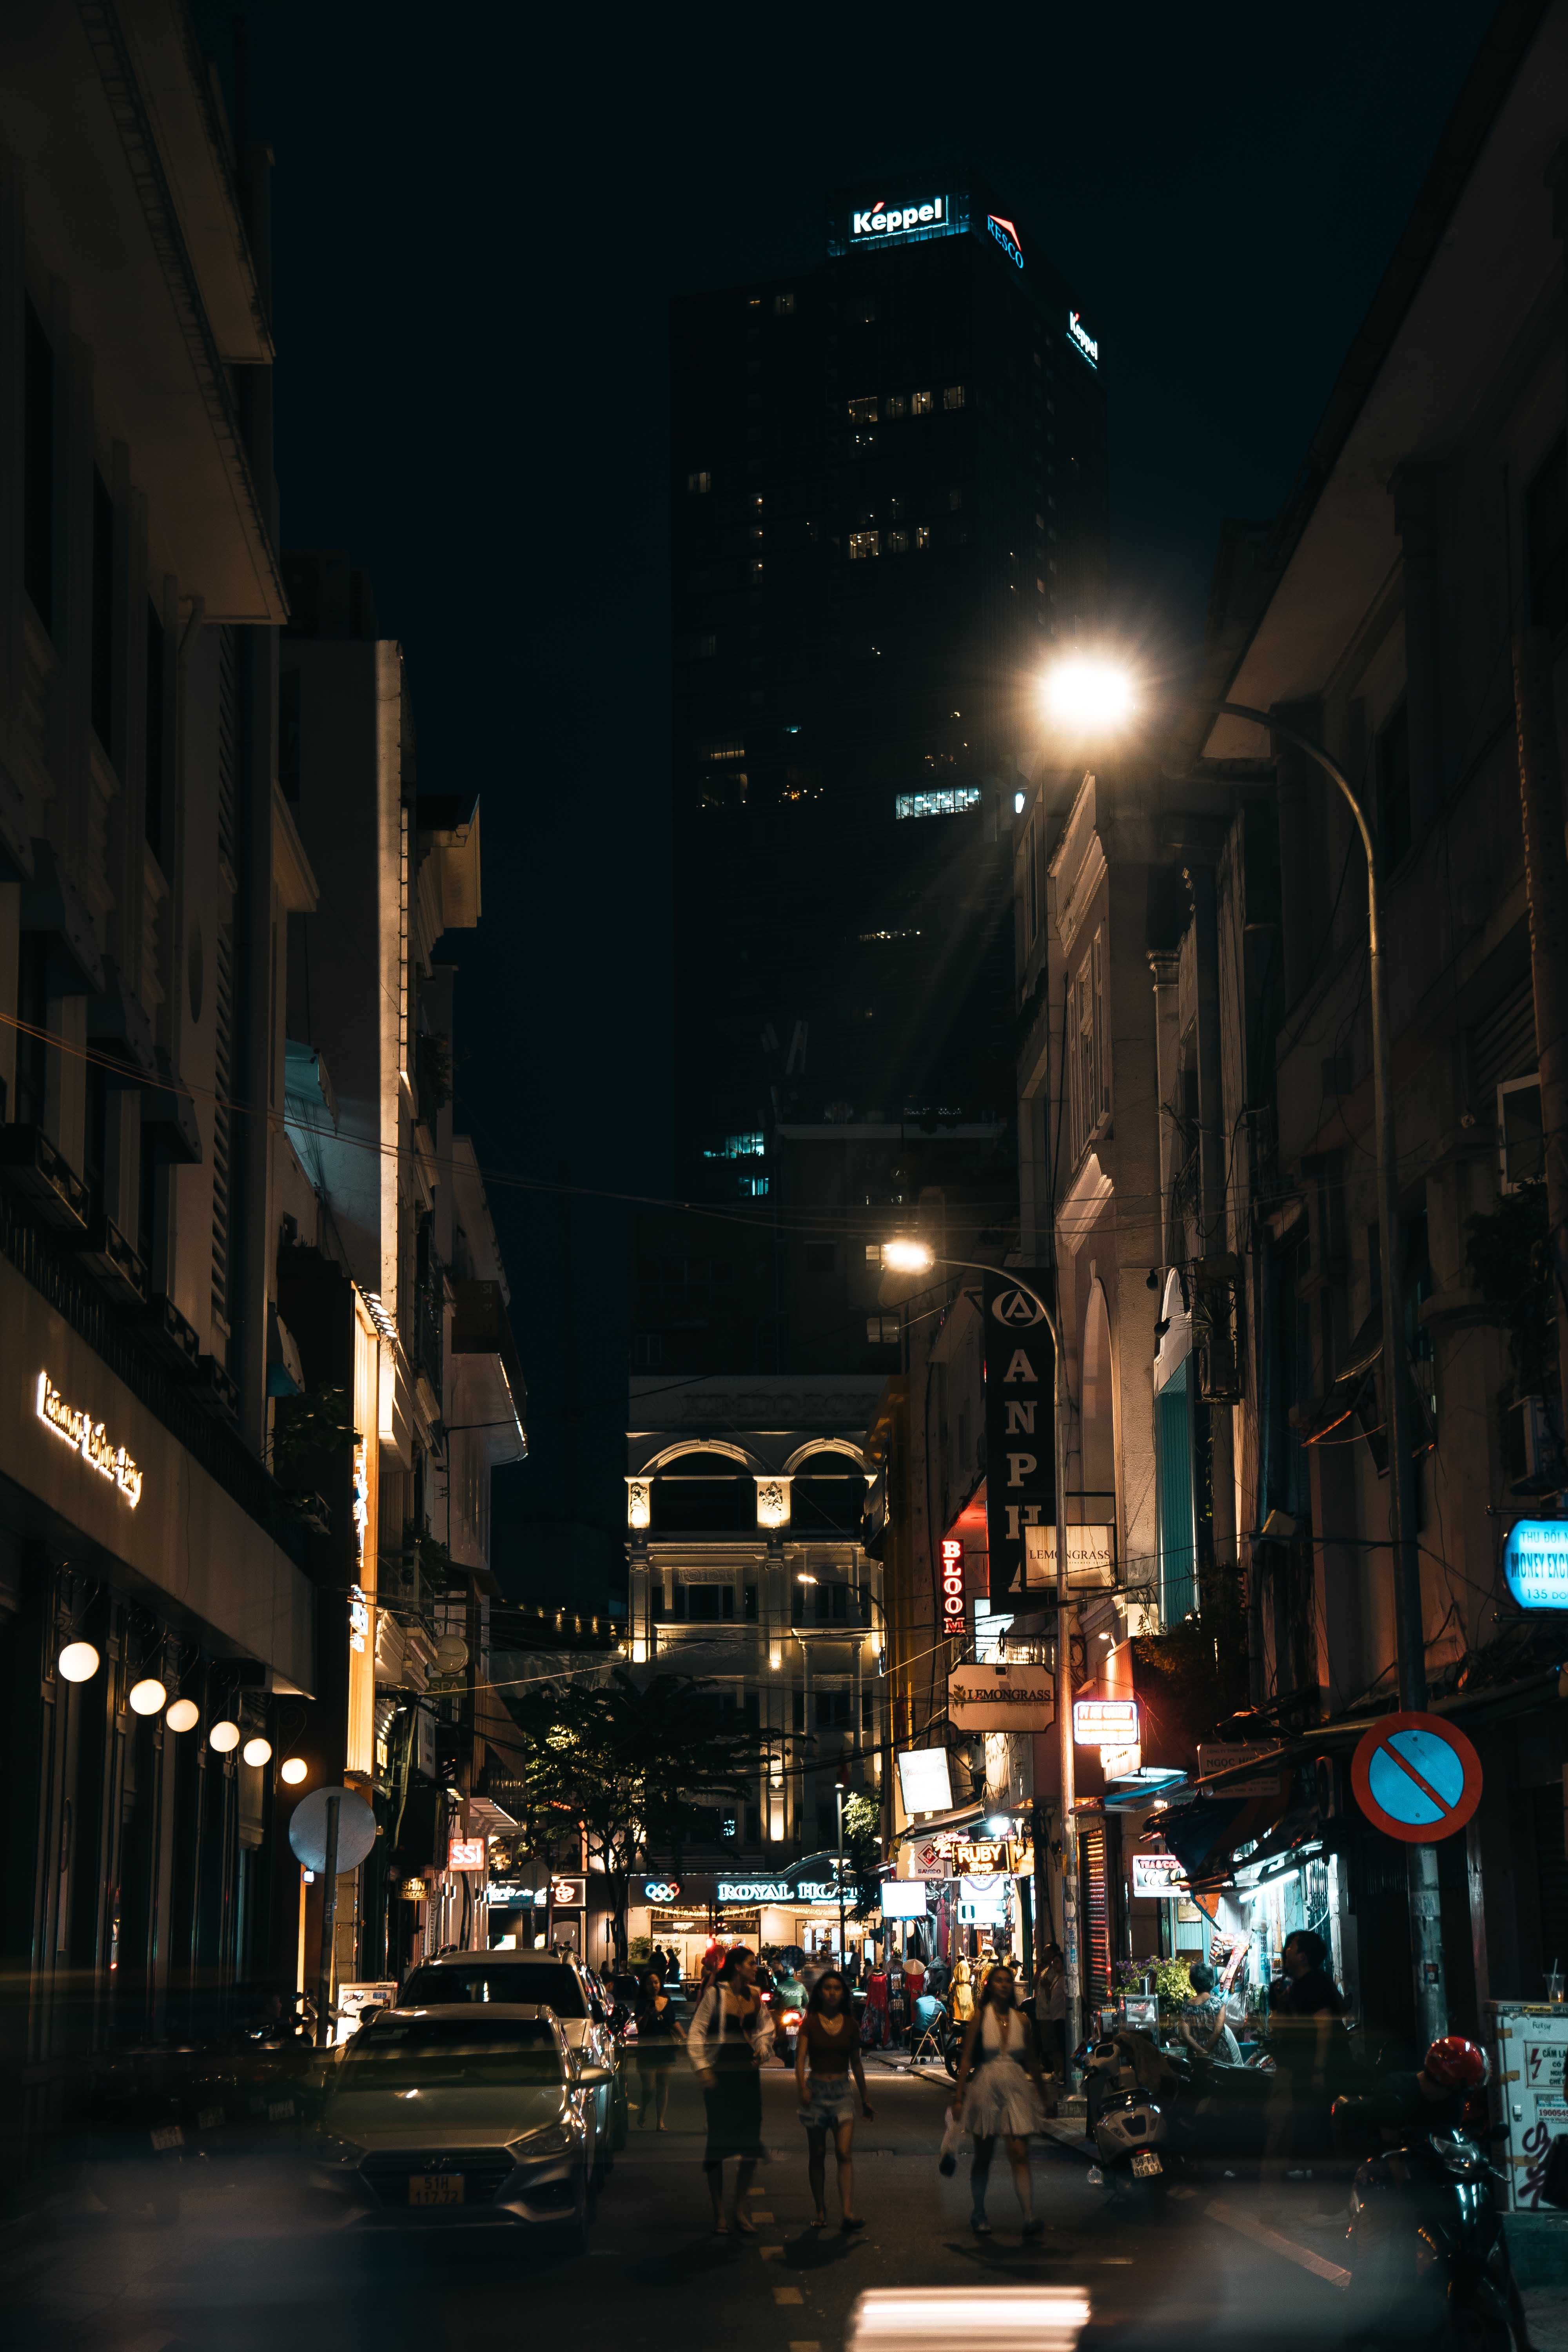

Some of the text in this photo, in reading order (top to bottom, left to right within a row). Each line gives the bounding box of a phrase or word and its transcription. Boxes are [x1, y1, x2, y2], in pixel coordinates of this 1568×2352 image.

[987, 215, 1023, 269] RESCO
[1521, 1532, 1539, 1543] THU
[1029, 1550, 1111, 1560] LEMNGRASS
[1511, 1552, 1544, 1578] MONEY
[942, 1540, 965, 1634] BLOOM
[1527, 1589, 1548, 1599] 135
[431, 1681, 459, 1692] SPA
[967, 1689, 1051, 1700] LEMONGRASS
[452, 1845, 481, 1864] SSI
[958, 1844, 1002, 1864] RUBY
[969, 1862, 994, 1873] Shop
[402, 1881, 425, 1891] SHIN
[717, 1883, 795, 1900] ROYAL
